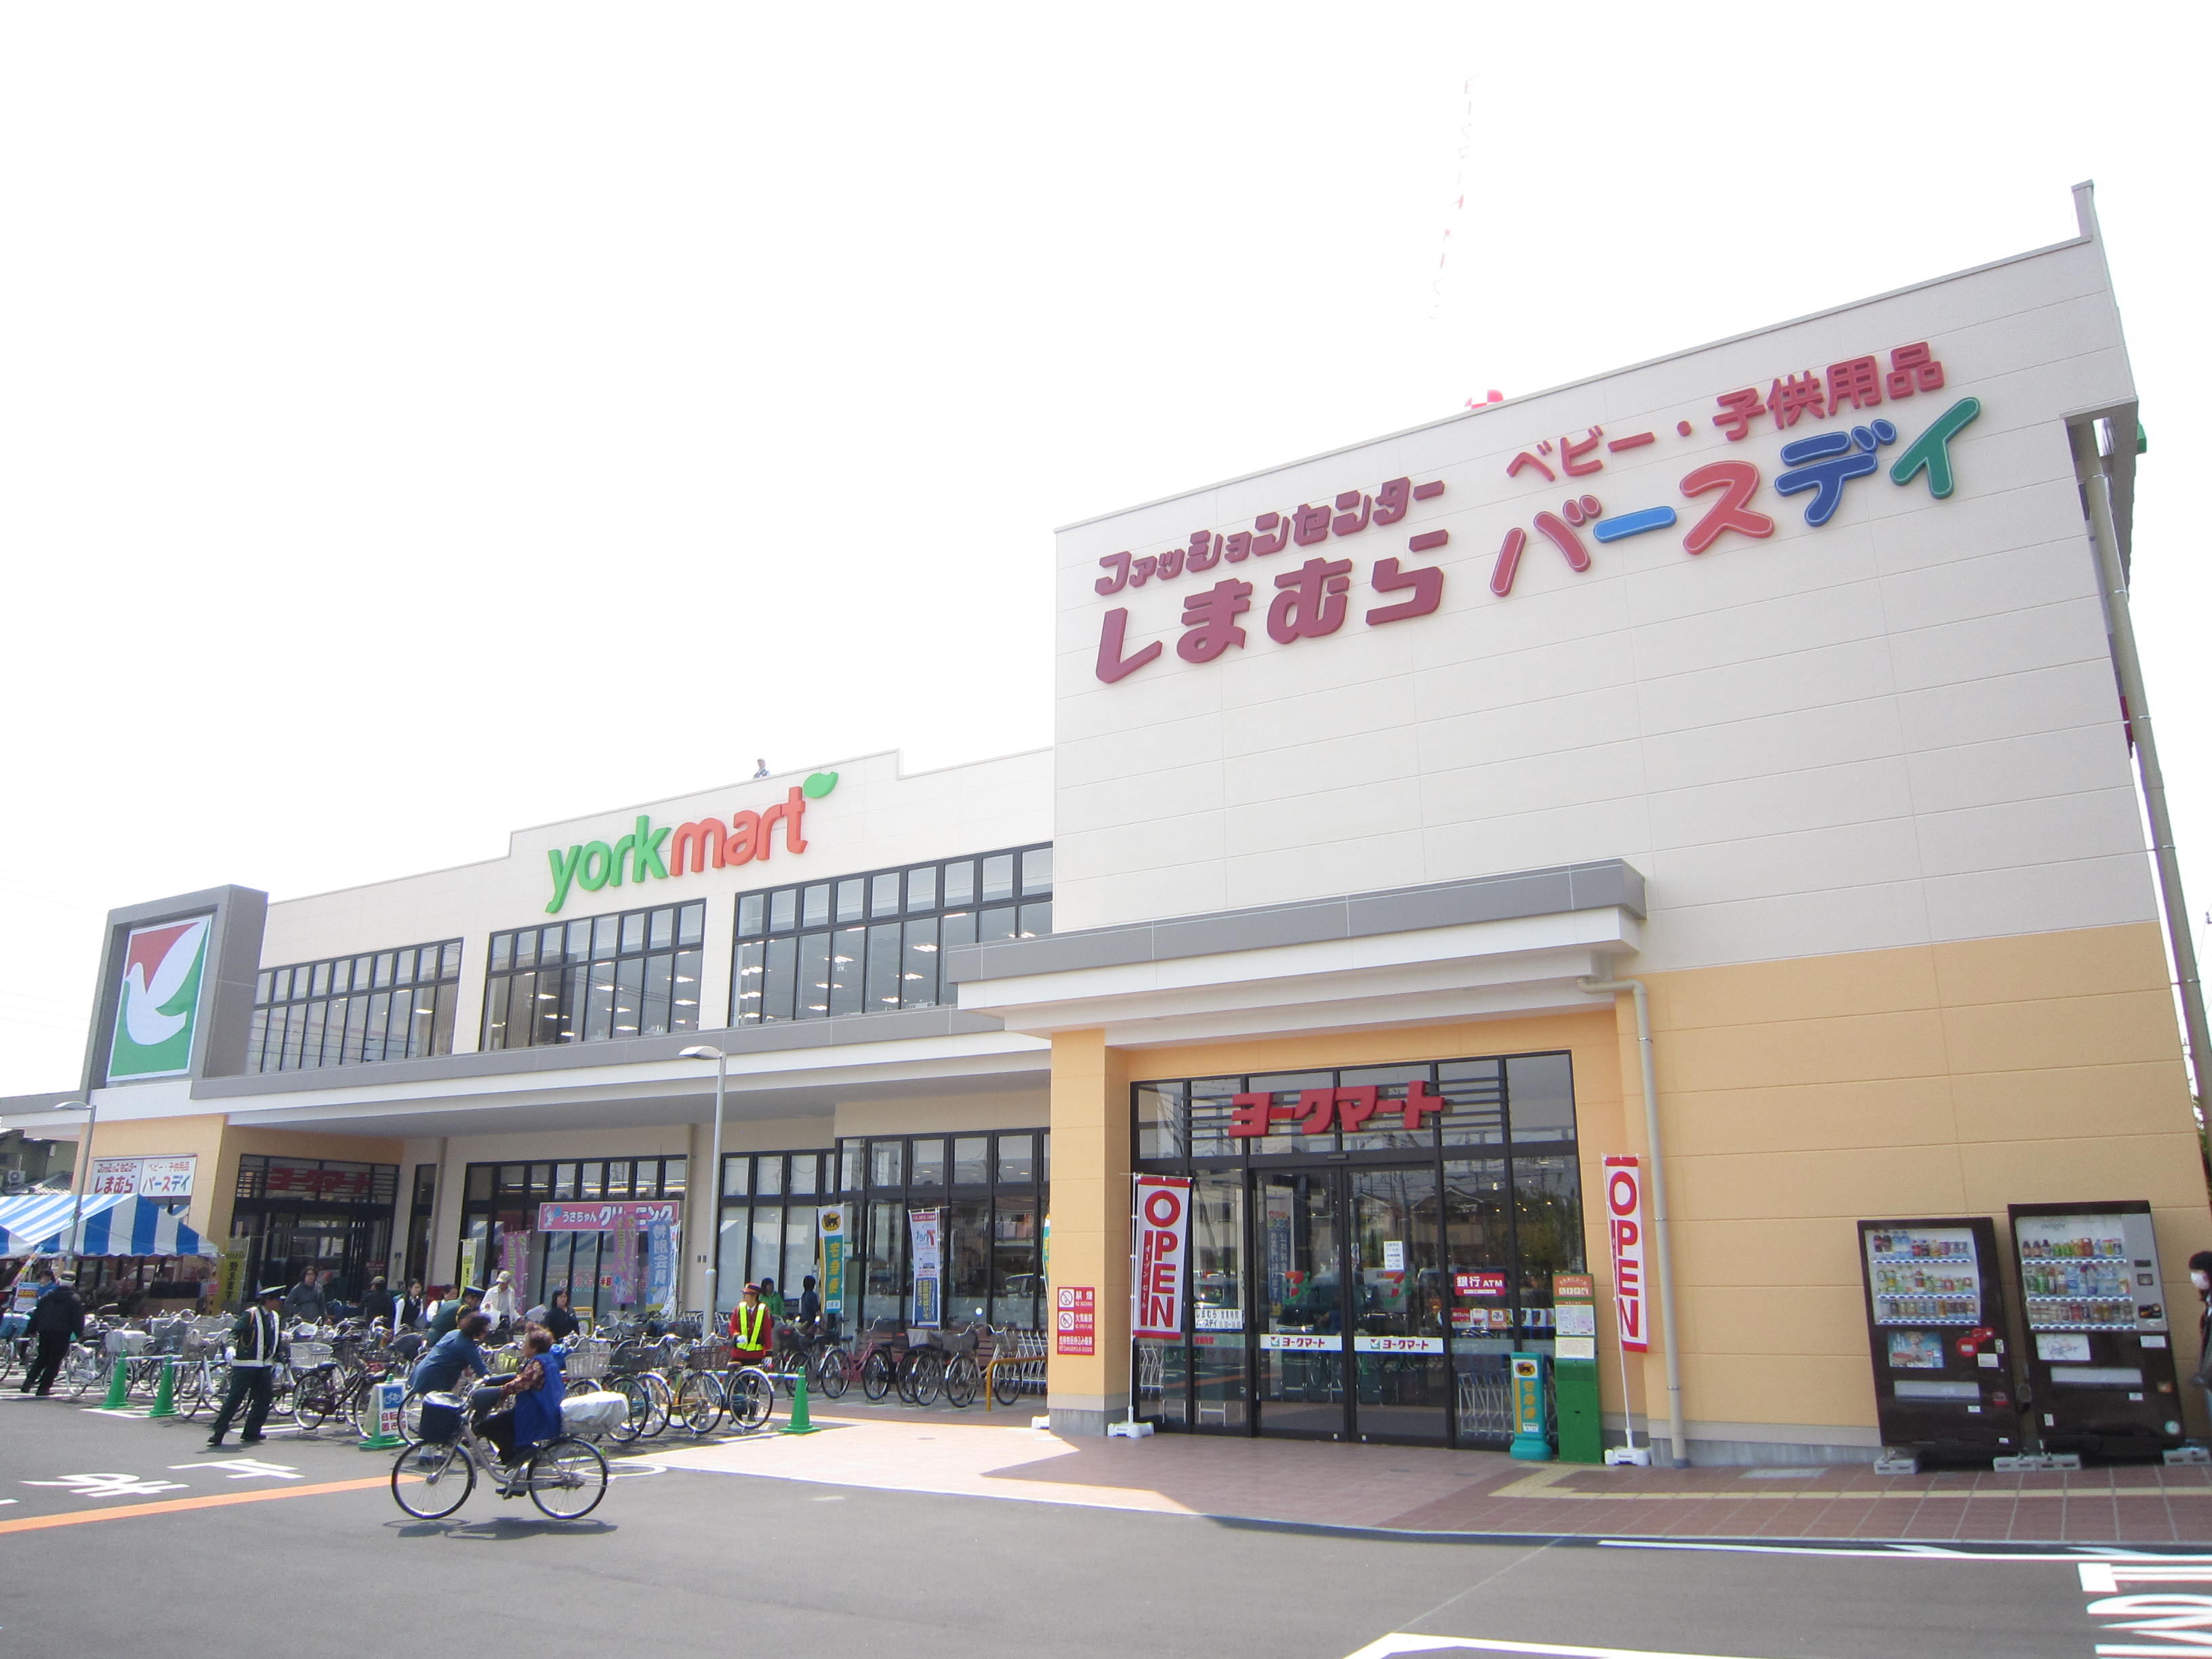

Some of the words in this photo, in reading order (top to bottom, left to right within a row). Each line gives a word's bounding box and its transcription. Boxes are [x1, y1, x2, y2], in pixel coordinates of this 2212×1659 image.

[1506, 341, 1945, 482] ベビー・子供用品
[1490, 396, 1981, 597] バースデイ
[1094, 476, 1445, 596] ファッションセンター
[1095, 529, 1449, 684] しまむら
[545, 786, 808, 914] yorkmart
[1228, 1080, 1445, 1137] ヨークマート
[94, 1175, 136, 1193] しまむら
[142, 1174, 191, 1192] バースデイ
[265, 1166, 374, 1195] ヨークマート
[562, 1210, 597, 1223] うさちゃん
[599, 1204, 673, 1227] クリニング
[1145, 1189, 1181, 1328] OPEN
[1609, 1170, 1639, 1338] OPEN
[1076, 1290, 1093, 1300] 禁煙
[1456, 1275, 1480, 1287] 銀行
[1195, 1309, 1218, 1319] しまむら
[1282, 1337, 1326, 1348] ヨークマート
[1382, 1339, 1429, 1350] ヨークマート
